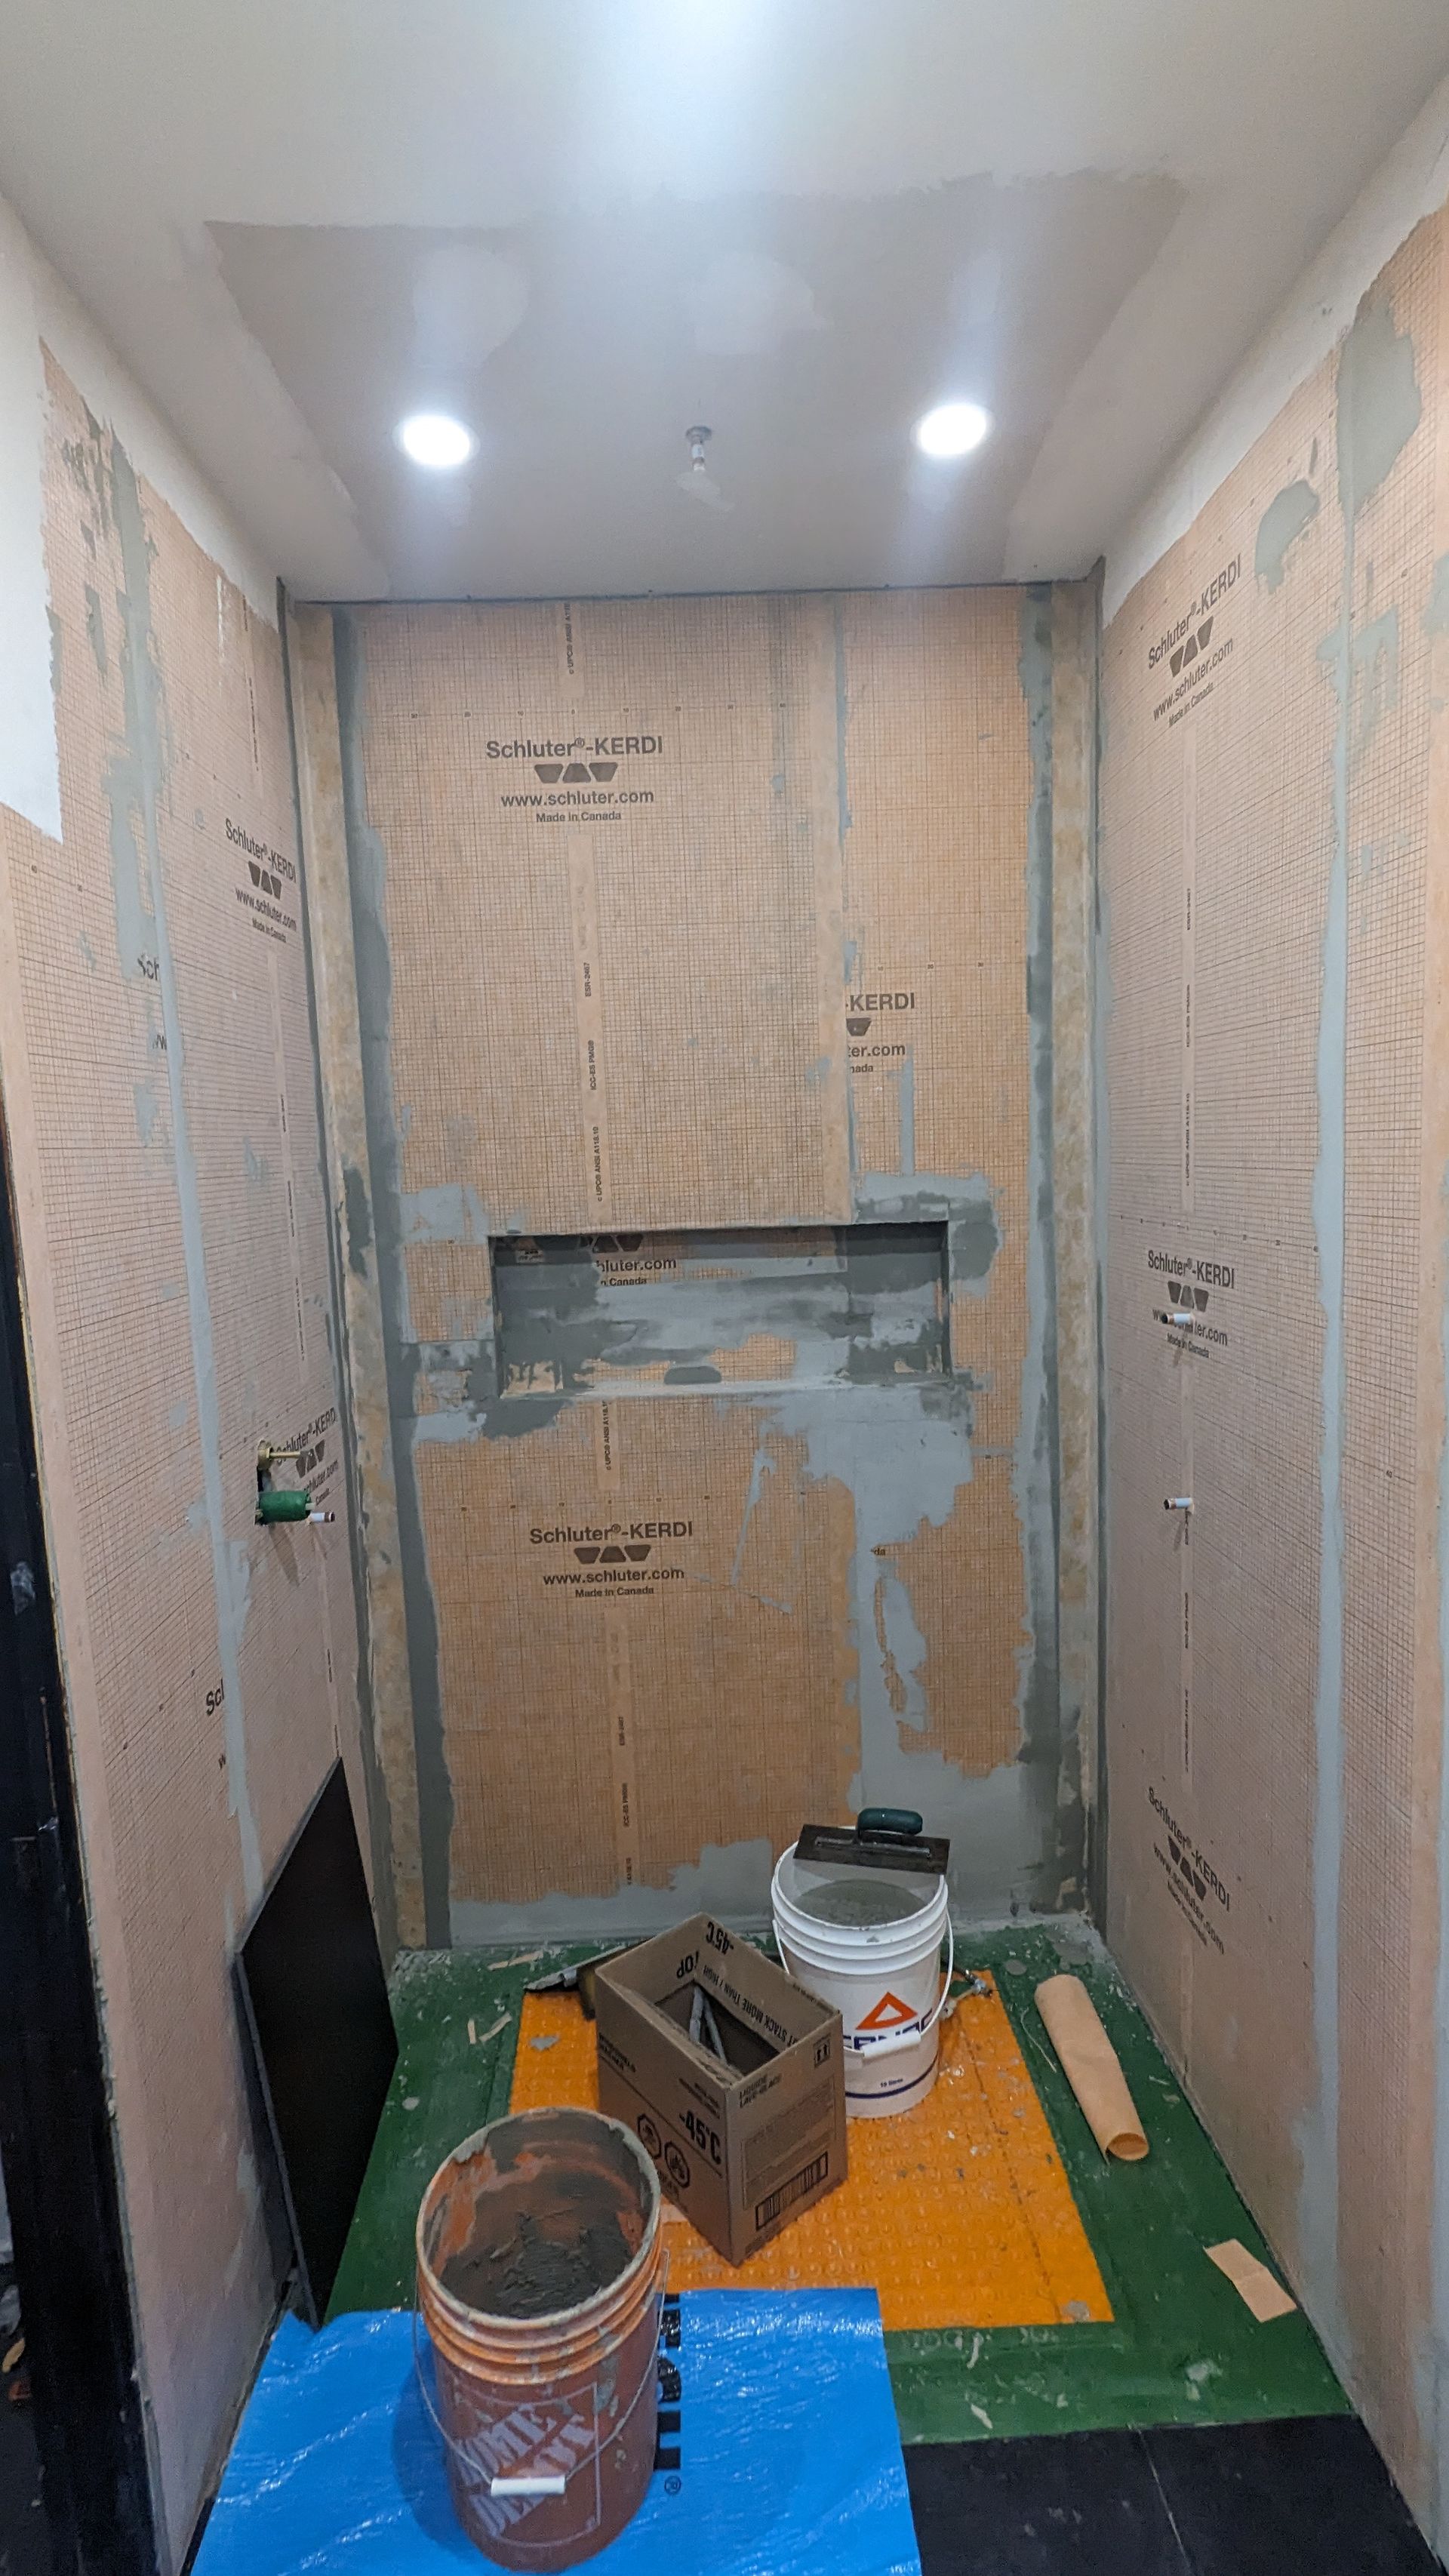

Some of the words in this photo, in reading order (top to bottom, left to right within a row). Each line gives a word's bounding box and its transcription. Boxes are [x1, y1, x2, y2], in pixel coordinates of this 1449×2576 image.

[500, 790, 655, 808] www.schluter.com
[536, 812, 566, 823] Made
[568, 811, 578, 822] in
[580, 811, 622, 821] Canada
[609, 1276, 648, 1287] Canada
[543, 1567, 685, 1586] www.schluter.com
[575, 1588, 603, 1599] Made
[617, 1586, 655, 1596] Canada
